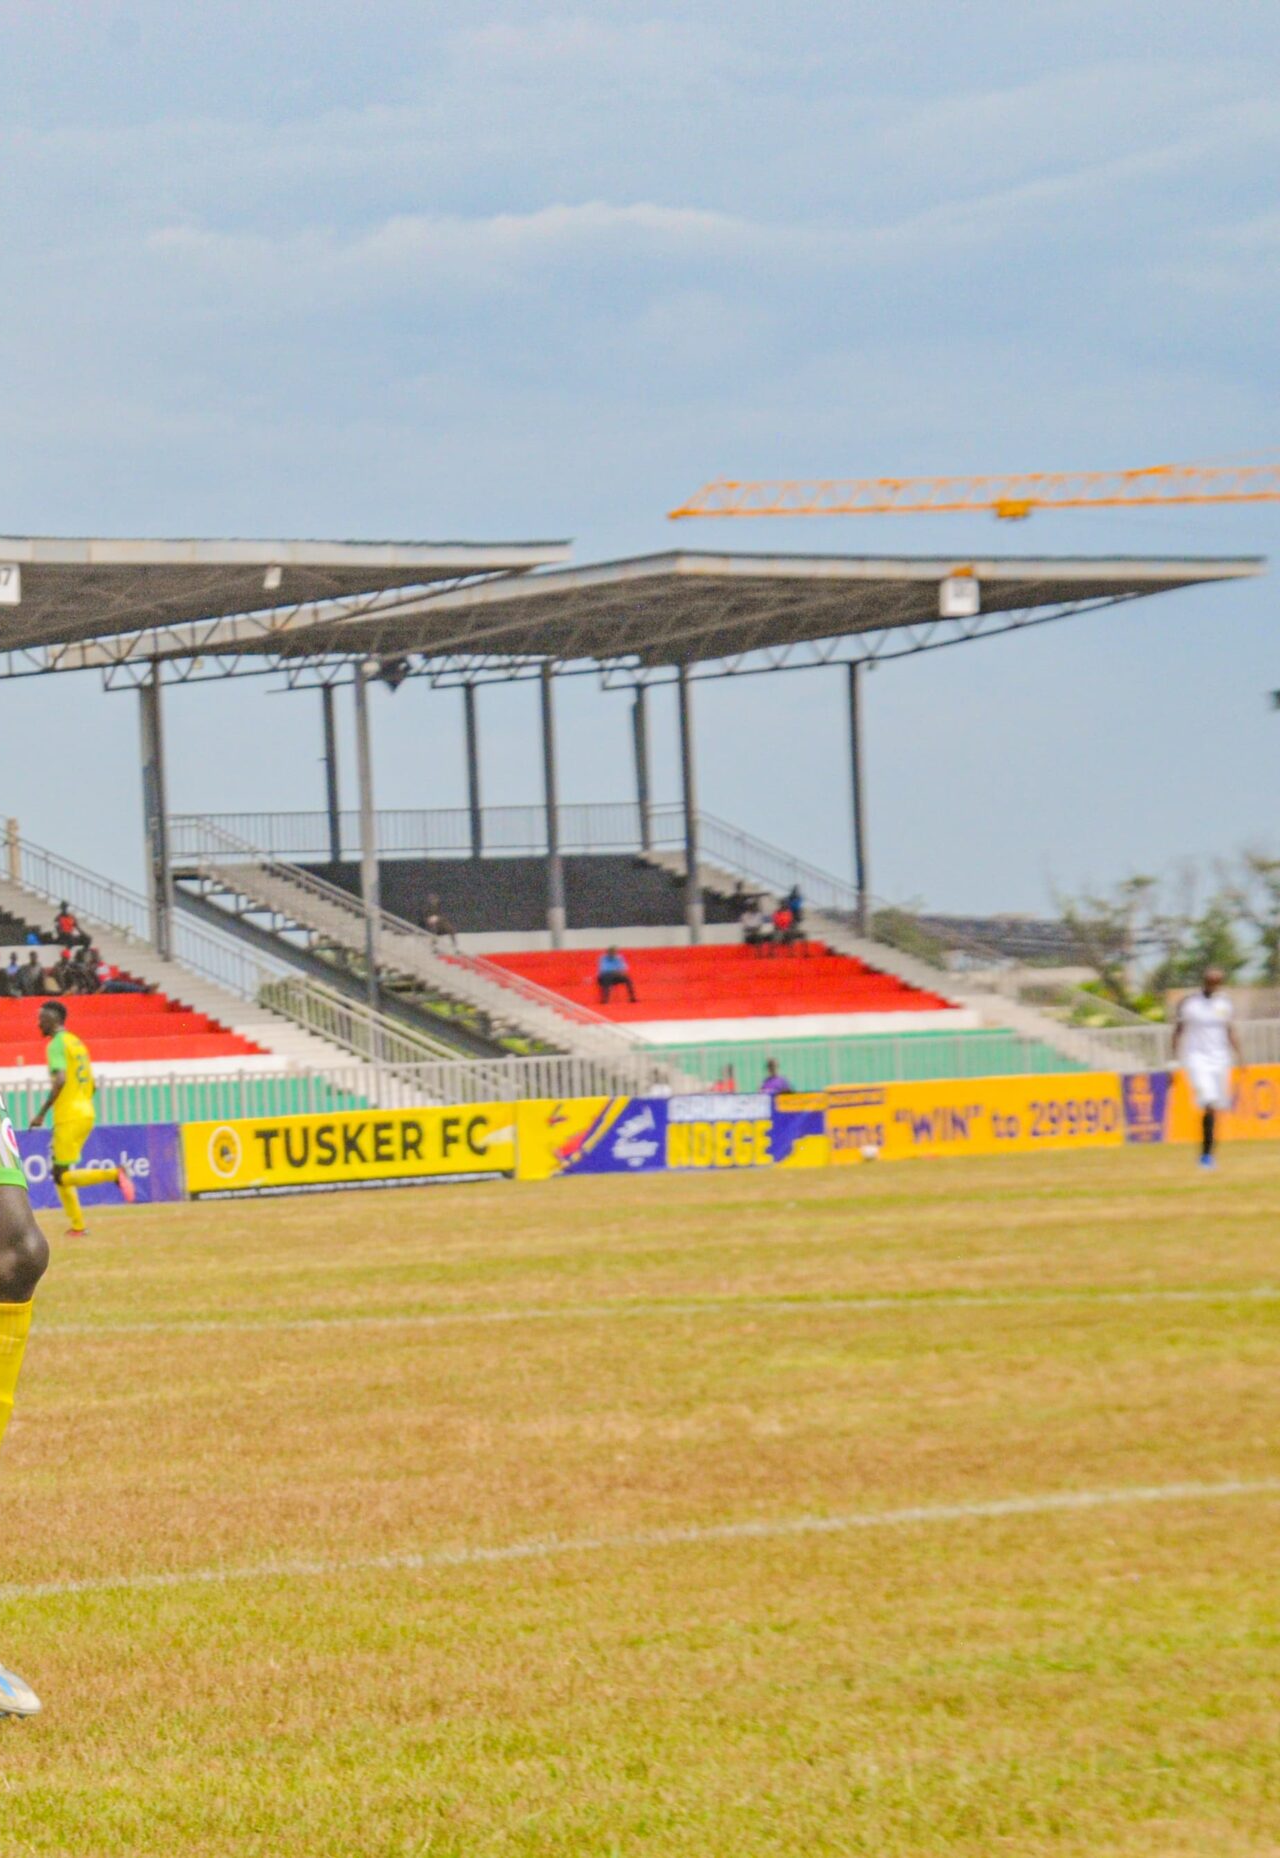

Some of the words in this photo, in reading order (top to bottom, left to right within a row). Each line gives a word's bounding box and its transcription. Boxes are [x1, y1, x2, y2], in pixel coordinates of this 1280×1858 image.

[255, 1120, 425, 1170] TUSKER
[441, 1116, 490, 1157] FC
[665, 1120, 774, 1168] NDEGE
[991, 1114, 1020, 1140] to
